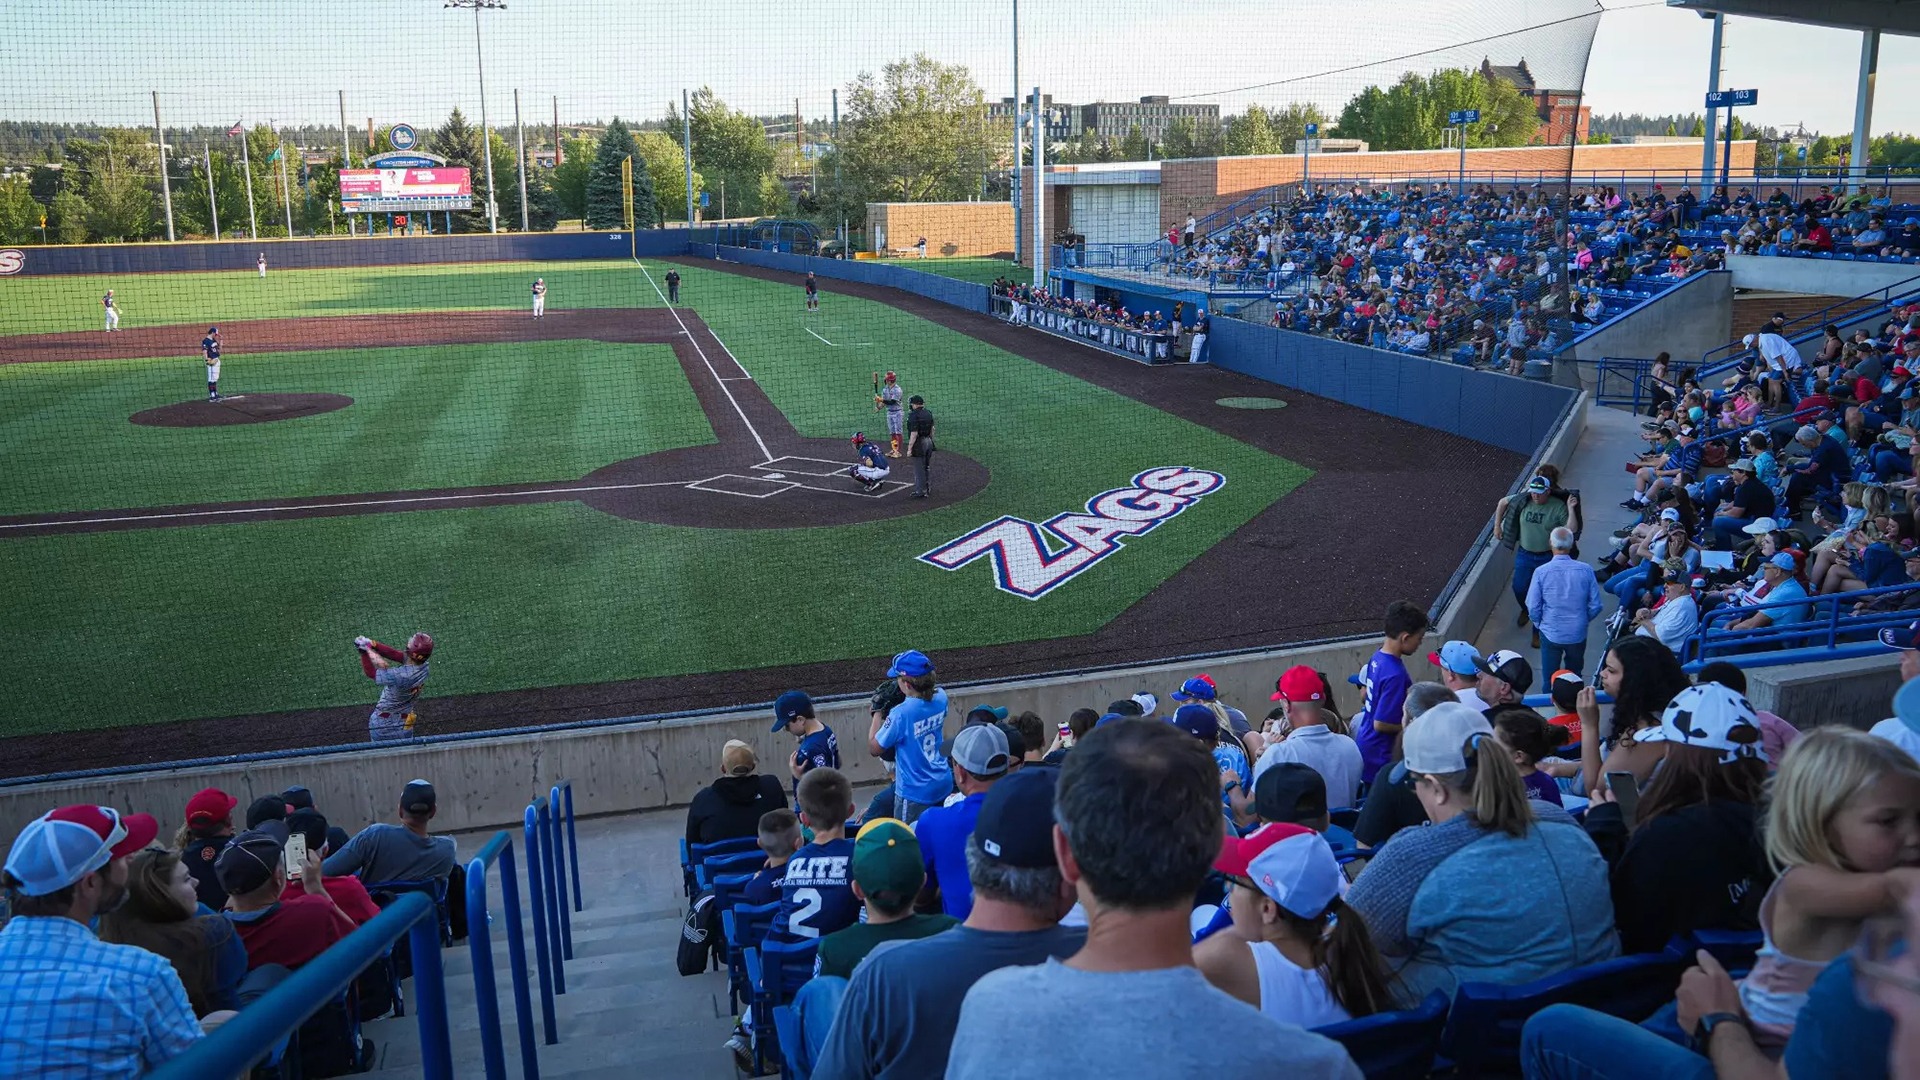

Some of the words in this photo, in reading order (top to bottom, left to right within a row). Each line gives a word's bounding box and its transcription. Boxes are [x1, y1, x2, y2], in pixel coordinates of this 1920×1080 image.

[1708, 92, 1722, 101] 102
[1735, 90, 1749, 99] 103
[395, 216, 406, 226] 20
[1526, 511, 1545, 524] CAT
[915, 466, 1227, 600] ZAGS
[914, 711, 945, 737] ELITE
[923, 733, 936, 763] 8
[789, 888, 822, 938] 2
